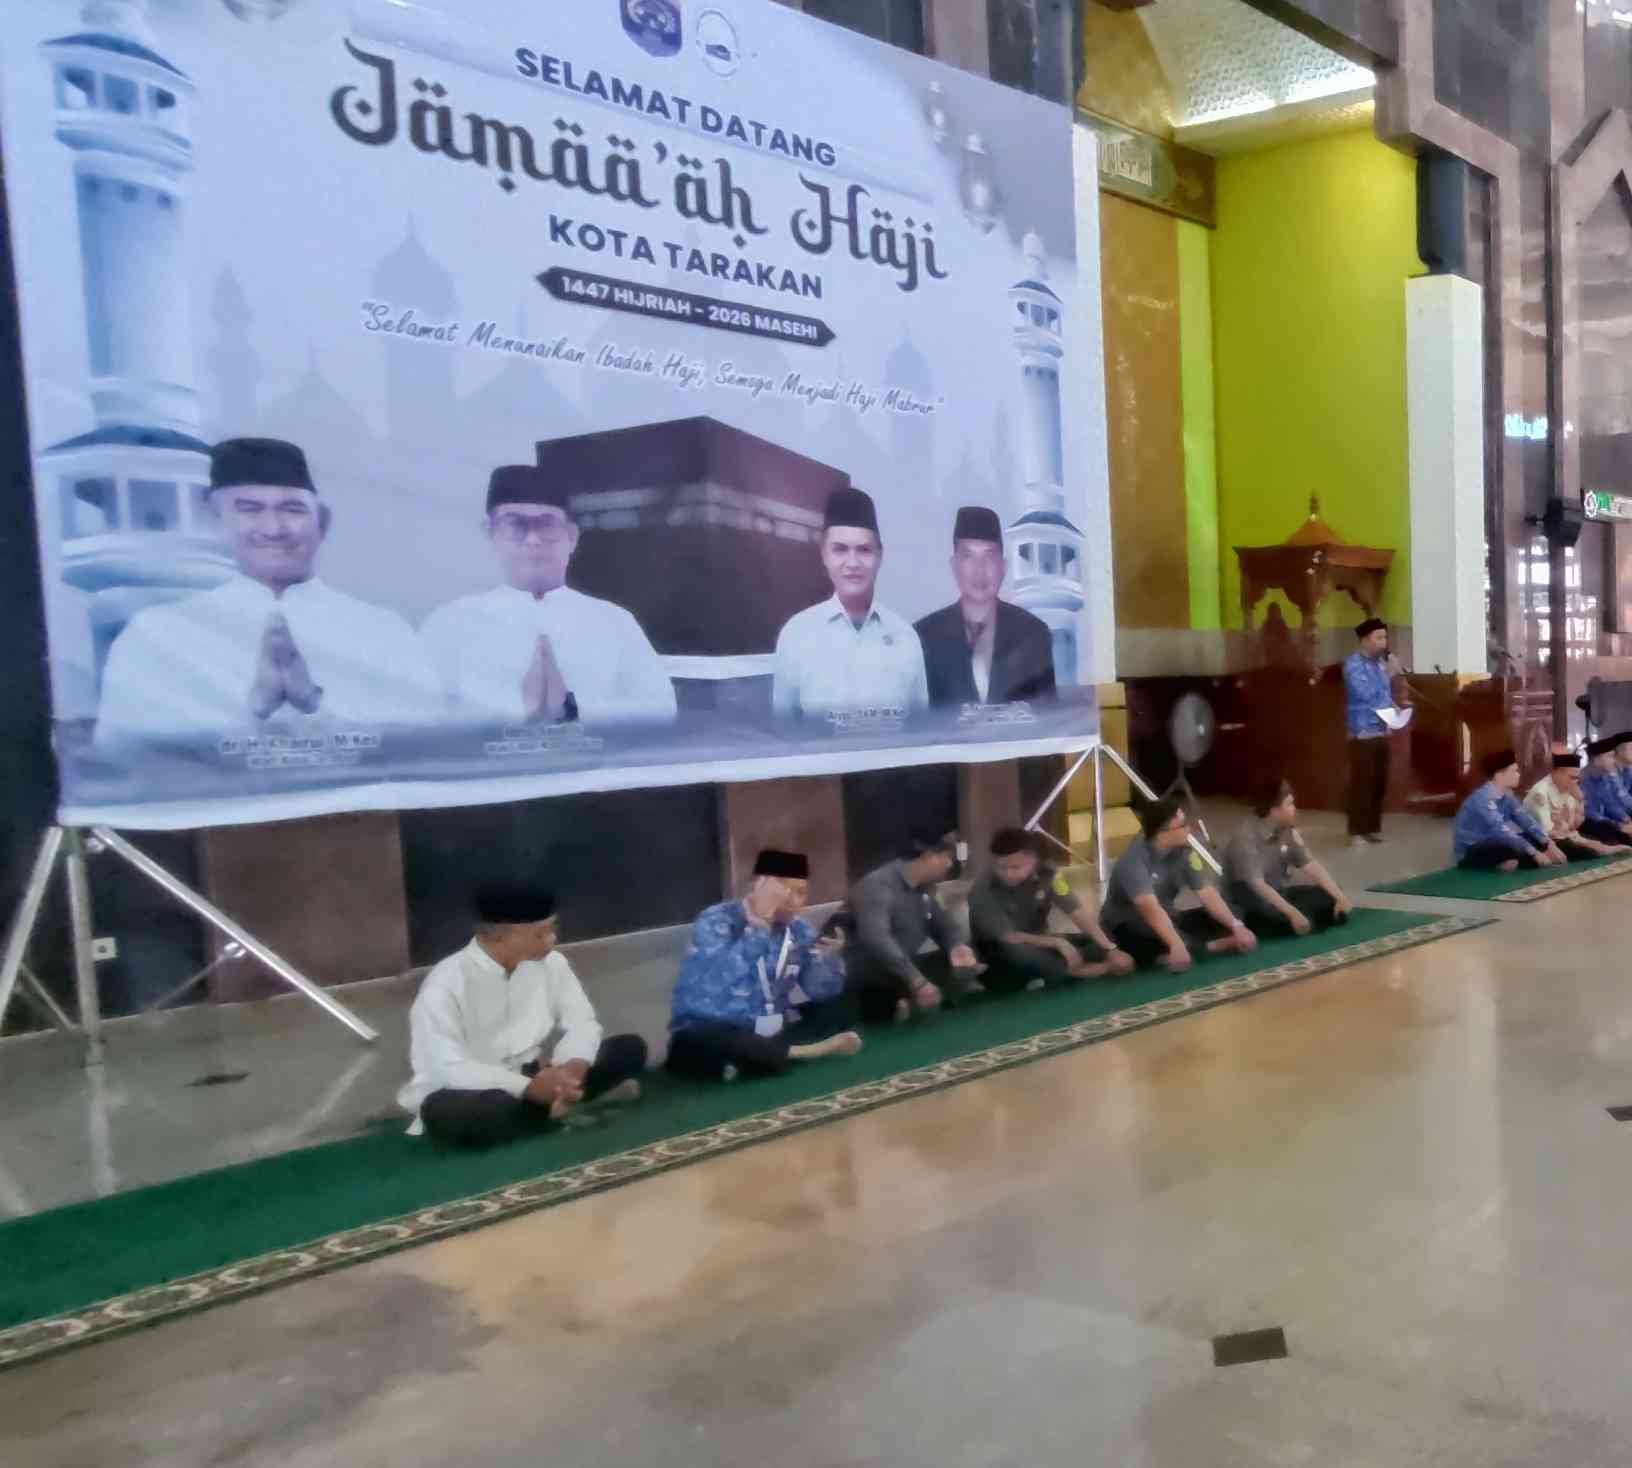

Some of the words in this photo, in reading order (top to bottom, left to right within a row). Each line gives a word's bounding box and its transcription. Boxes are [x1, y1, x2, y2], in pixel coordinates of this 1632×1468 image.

[515, 47, 691, 124] SELAMAT
[700, 105, 837, 167] DATANG
[549, 213, 656, 265] KOTA
[662, 241, 823, 299] TARAKAN
[560, 275, 609, 300] 1447
[613, 287, 691, 316] HIJRIAH
[707, 304, 751, 327] 2026
[754, 314, 817, 340] MASEHI
[595, 343, 654, 374] Ibadah
[662, 352, 705, 388] Haji,
[714, 362, 773, 396] Semoga
[781, 373, 839, 402] Menjadi
[844, 383, 878, 413] Haji
